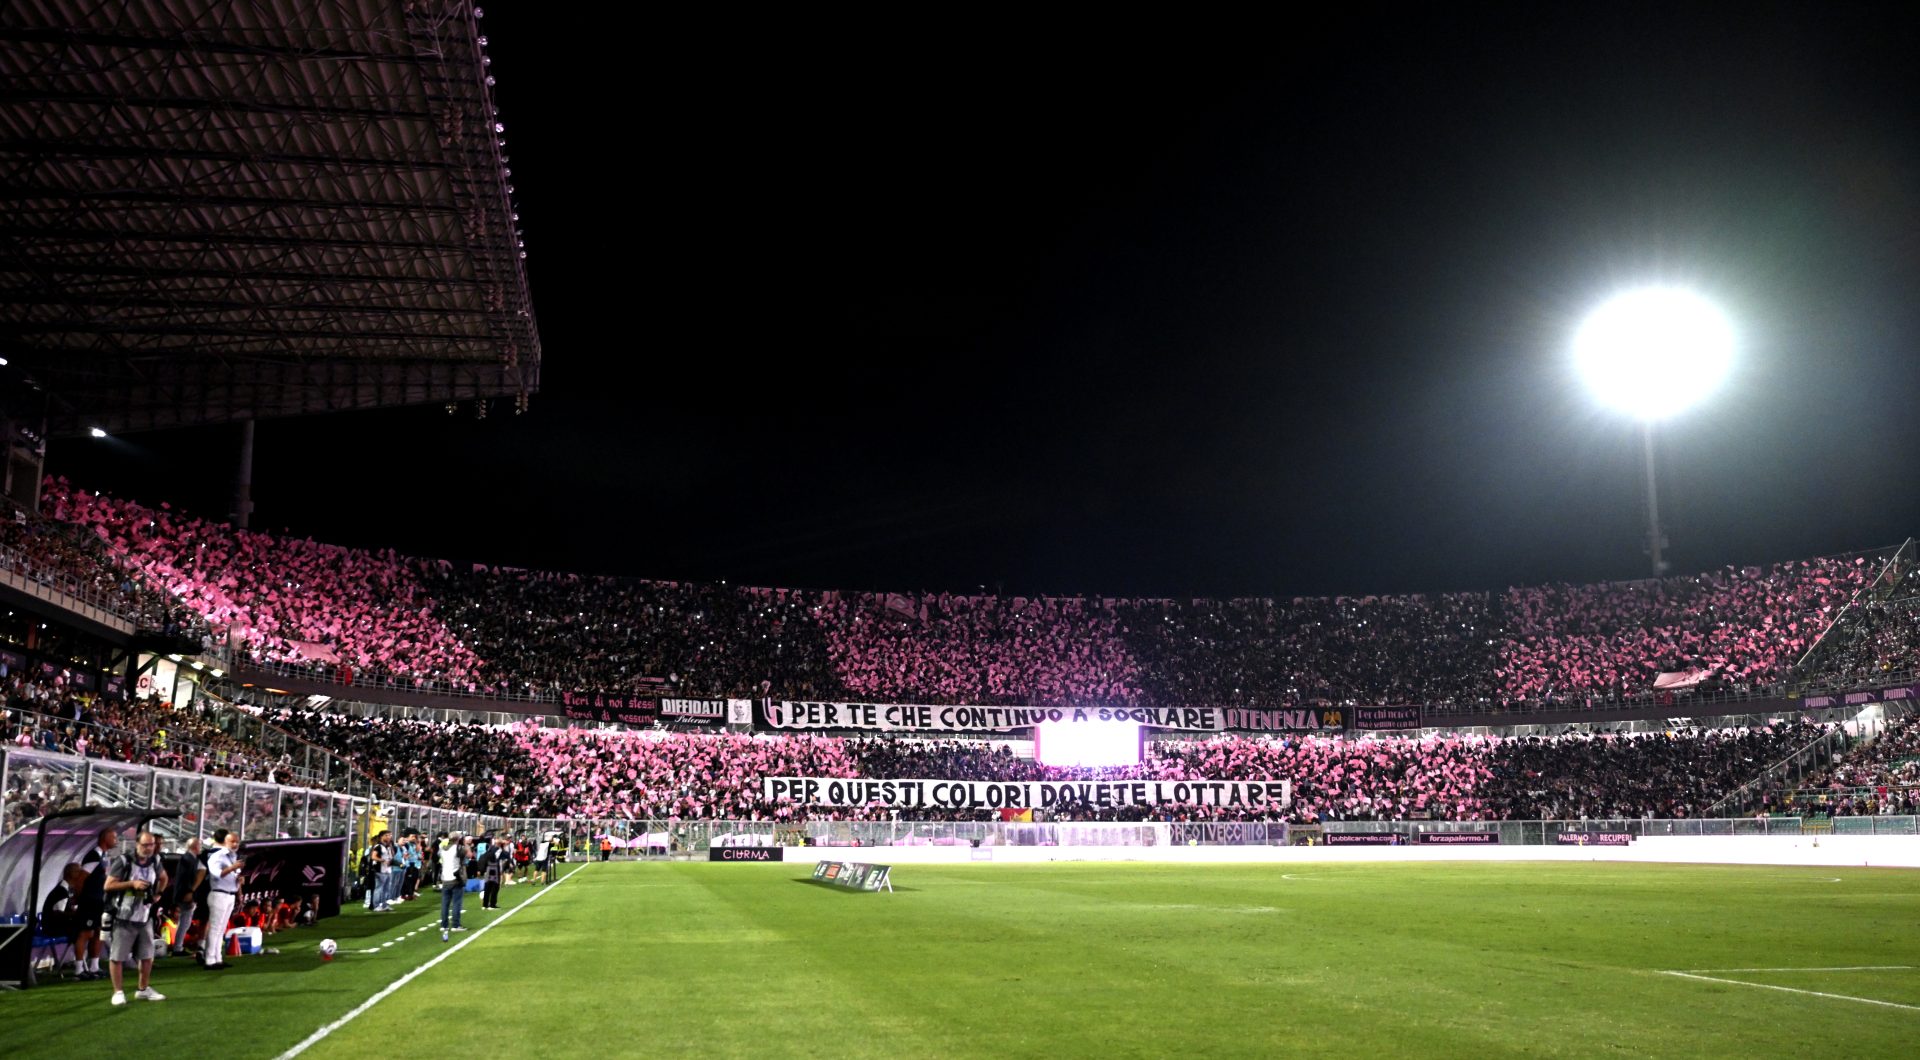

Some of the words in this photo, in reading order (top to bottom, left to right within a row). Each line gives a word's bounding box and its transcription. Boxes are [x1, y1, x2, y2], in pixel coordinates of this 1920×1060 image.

[1845, 692, 1868, 704] PUMA
[1883, 687, 1907, 700] PUMA
[594, 694, 604, 708] di
[608, 697, 623, 708] noi
[628, 697, 656, 709] stessi
[661, 698, 724, 716] DIFFIDATI
[1805, 696, 1829, 708] PUMA
[601, 709, 611, 721] di
[674, 716, 711, 724] Palermo
[791, 703, 838, 724] PER
[847, 704, 877, 725] TE
[885, 706, 931, 727] CHE
[940, 707, 1063, 727] CONTINUO
[1072, 708, 1088, 722] A
[1099, 708, 1215, 729] SOGNARE
[771, 780, 820, 802] PER
[828, 781, 923, 806] QUESTI
[932, 783, 1031, 808] COLORI
[1040, 783, 1146, 807] DOVETE
[1155, 783, 1282, 806] LOTTARE
[1207, 823, 1264, 841] VECCHIO
[1429, 833, 1489, 843] forzapalermo.it
[723, 849, 770, 860] CIURMA
